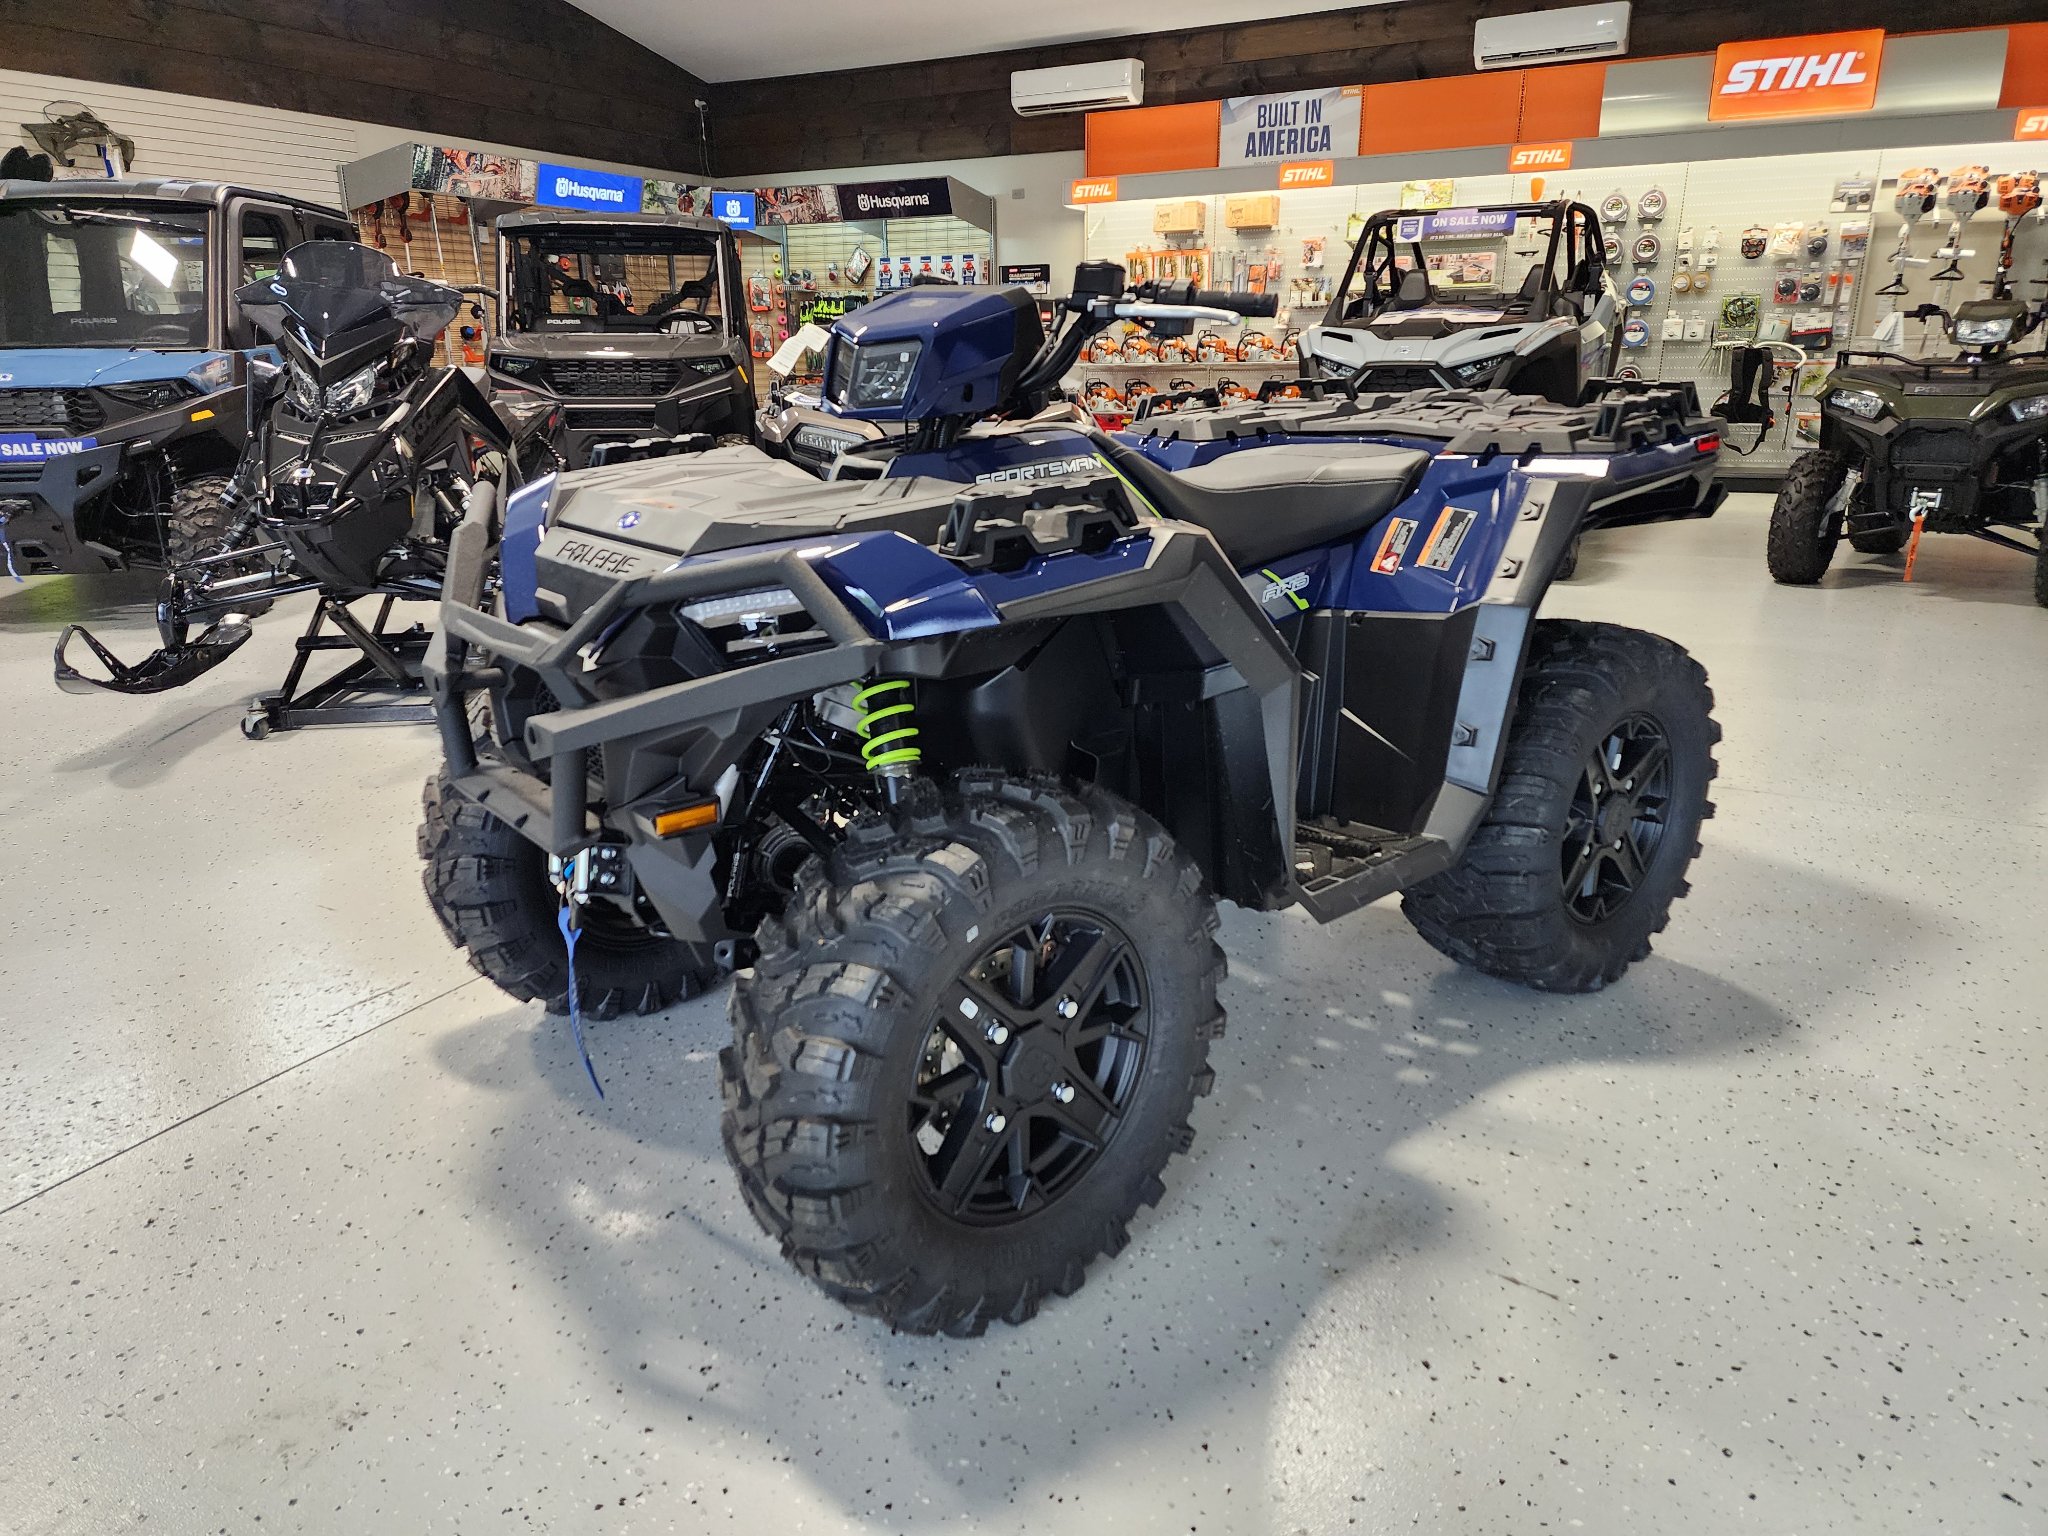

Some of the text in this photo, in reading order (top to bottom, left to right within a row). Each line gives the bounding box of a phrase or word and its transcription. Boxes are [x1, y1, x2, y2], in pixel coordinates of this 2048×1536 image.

[1720, 51, 1866, 94] STIHL
[1257, 98, 1322, 128] BUILT IN
[1245, 124, 1331, 158] AMERICA
[1513, 149, 1565, 165] STIHL
[1282, 167, 1327, 182] STIHL
[568, 180, 624, 202] Husqvarna
[1074, 184, 1112, 198] STIHL
[869, 194, 930, 209] Husqvarna
[1432, 213, 1507, 227] ON SALE NOW
[0, 441, 82, 456] SALE NOW
[975, 457, 1102, 484] SPORTSMAN
